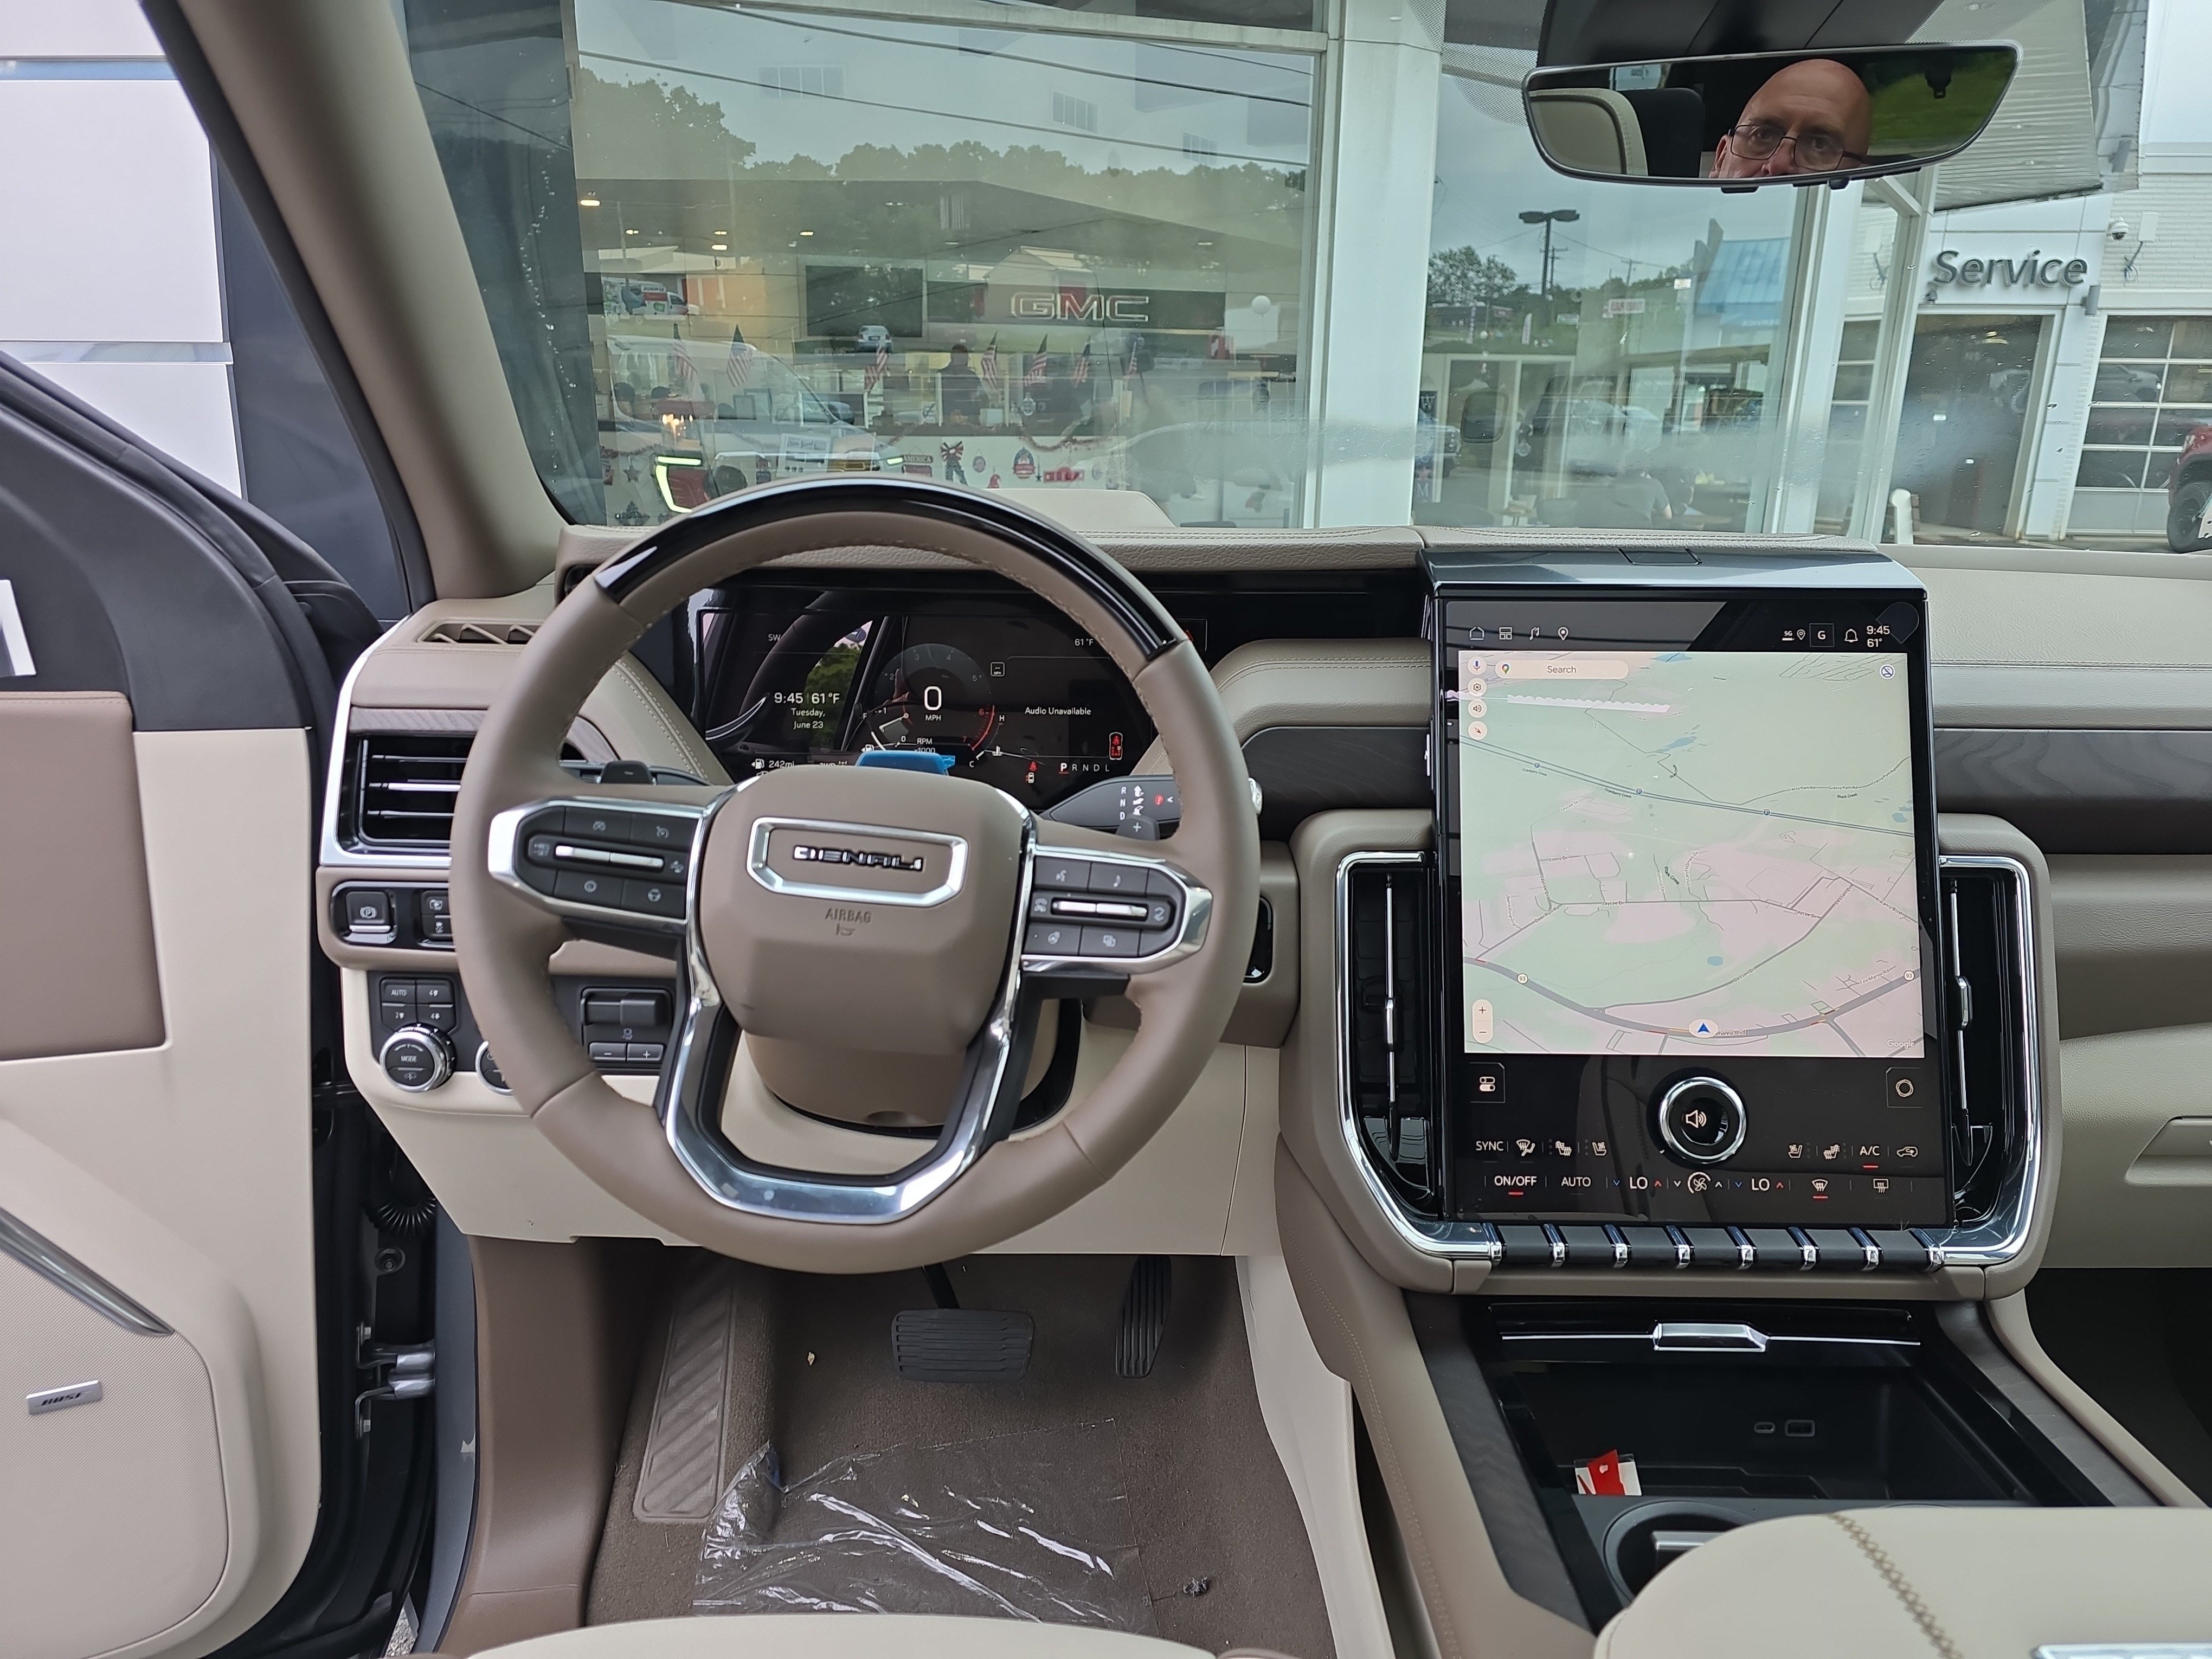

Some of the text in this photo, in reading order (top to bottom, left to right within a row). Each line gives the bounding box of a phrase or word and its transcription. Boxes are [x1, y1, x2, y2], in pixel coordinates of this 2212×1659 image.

[1933, 249, 2088, 287] Service
[1011, 291, 1149, 321] GMC
[1817, 630, 1826, 640] G
[1866, 625, 1891, 635] 9:45
[1867, 638, 1882, 647] 61°
[1547, 665, 1577, 674] Search
[774, 692, 803, 704] 9:45
[924, 686, 942, 711] 0
[791, 708, 826, 718] Tuesday,
[1025, 706, 1091, 715] Audio Unavailable
[793, 721, 811, 730] June
[1060, 763, 1068, 771] P
[1094, 764, 1099, 772] D
[1605, 788, 1621, 796] Cranberry
[1560, 803, 1574, 812] Jaycee
[1120, 812, 1126, 820] D
[793, 845, 924, 871] DENALI
[1875, 897, 1902, 915] Kiwanis Blvd
[825, 908, 872, 923] AIRBAG
[1535, 915, 1545, 923] Deer
[1868, 973, 1883, 981] Manor
[1887, 1039, 1914, 1049] Google
[1476, 1141, 1504, 1152] SYNC
[1860, 1146, 1880, 1156] A/C
[1494, 1175, 1537, 1186] ON/OFF
[1561, 1176, 1591, 1187] AUTO
[1629, 1176, 1648, 1189] LO
[1751, 1178, 1770, 1191] LO
